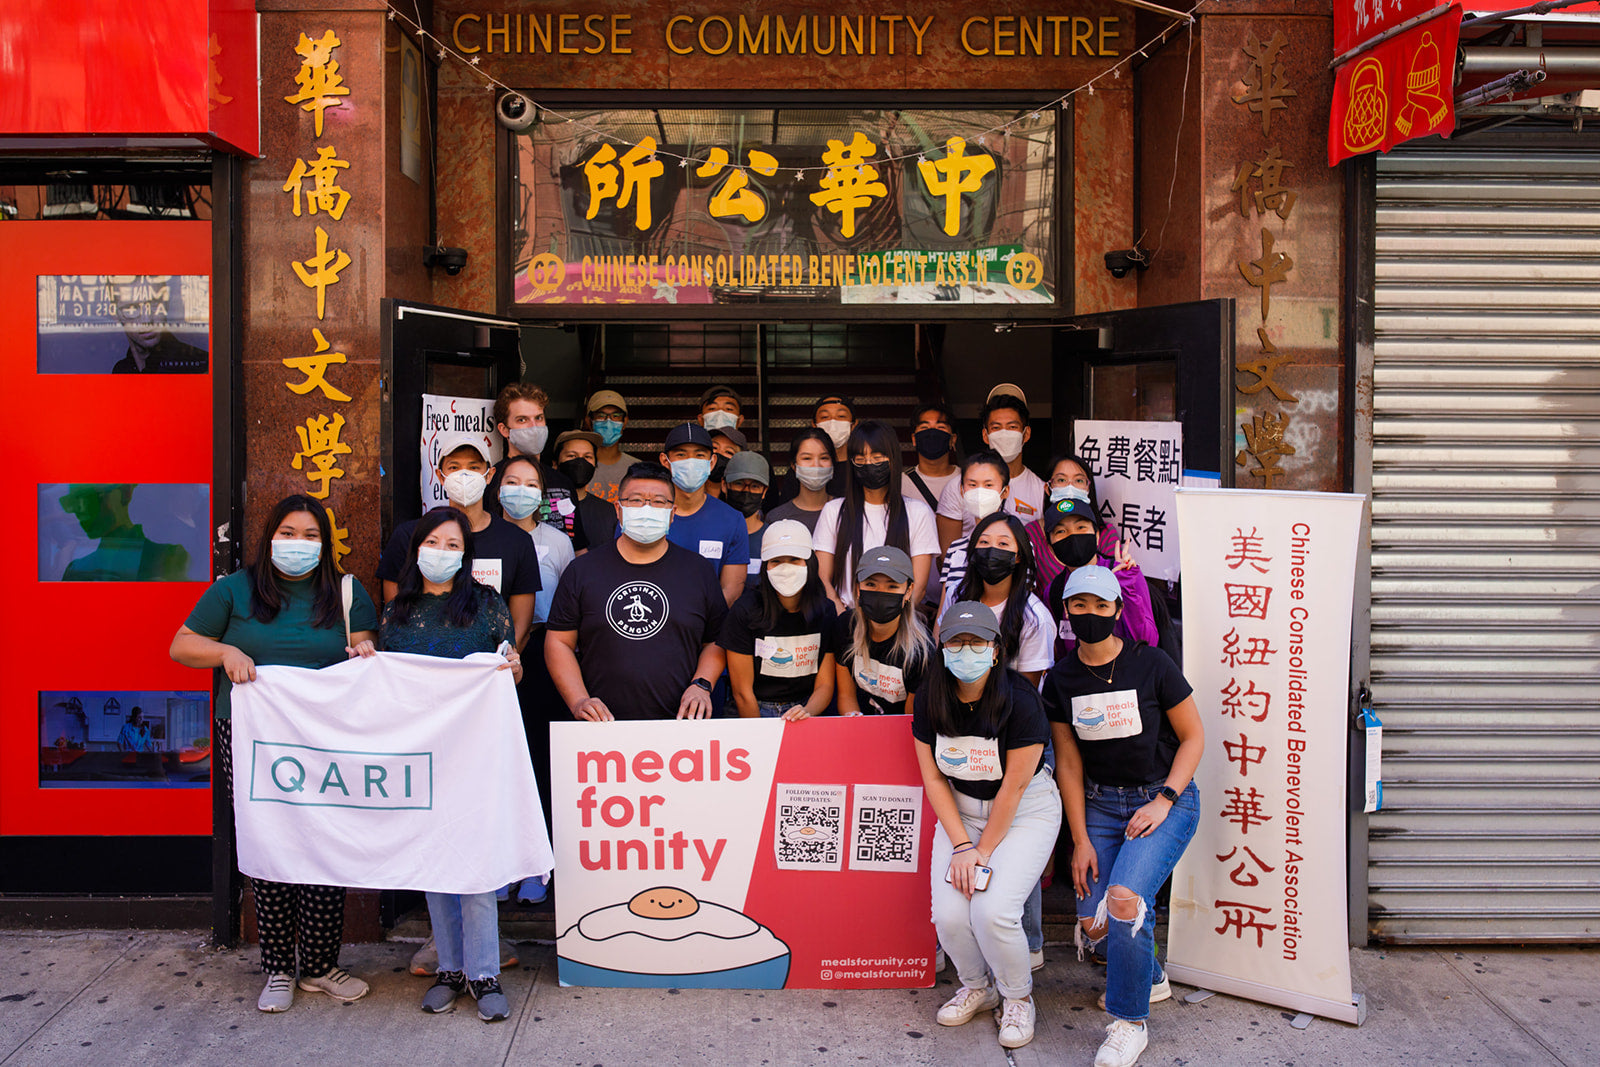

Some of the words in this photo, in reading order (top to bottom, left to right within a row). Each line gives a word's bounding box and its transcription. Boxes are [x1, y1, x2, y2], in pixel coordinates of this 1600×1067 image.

[452, 13, 633, 56] CHINESE
[665, 14, 934, 57] COMMUNITY
[960, 15, 1120, 58] CENTRE
[533, 260, 558, 284] 62
[581, 255, 658, 287] CHINESE
[665, 254, 802, 287] CONSOLIDATED
[809, 254, 927, 287] BENEVOLENT
[935, 254, 988, 287] ASS'N
[1013, 261, 1037, 284] 62
[426, 404, 449, 432] Free
[454, 407, 495, 433] meals
[1079, 435, 1180, 485] 免費餐點
[1290, 523, 1311, 601] Chinese
[472, 568, 499, 577] meals
[617, 586, 658, 601] ORIGINAL
[617, 619, 658, 634] PENGUIN
[795, 643, 818, 653] meals
[795, 659, 814, 668] unity
[796, 652, 808, 660] for
[1287, 607, 1309, 733] Consolidated
[879, 673, 901, 684] meals
[879, 679, 890, 689] for
[1106, 701, 1135, 711] meals
[1107, 710, 1121, 720] for
[1108, 716, 1133, 728] unity
[1214, 526, 1279, 949] 美國紐約中華公所
[970, 748, 996, 757] meals
[577, 740, 751, 783] meals
[970, 756, 983, 765] for
[970, 763, 994, 774] unity
[270, 755, 412, 799] QARI
[1284, 738, 1307, 846] Benevolent
[577, 786, 666, 827] for
[579, 828, 727, 881] unity
[1283, 849, 1304, 961] Association
[821, 956, 929, 968] mealsforunity.org
[834, 968, 927, 980] @mealsforunity
